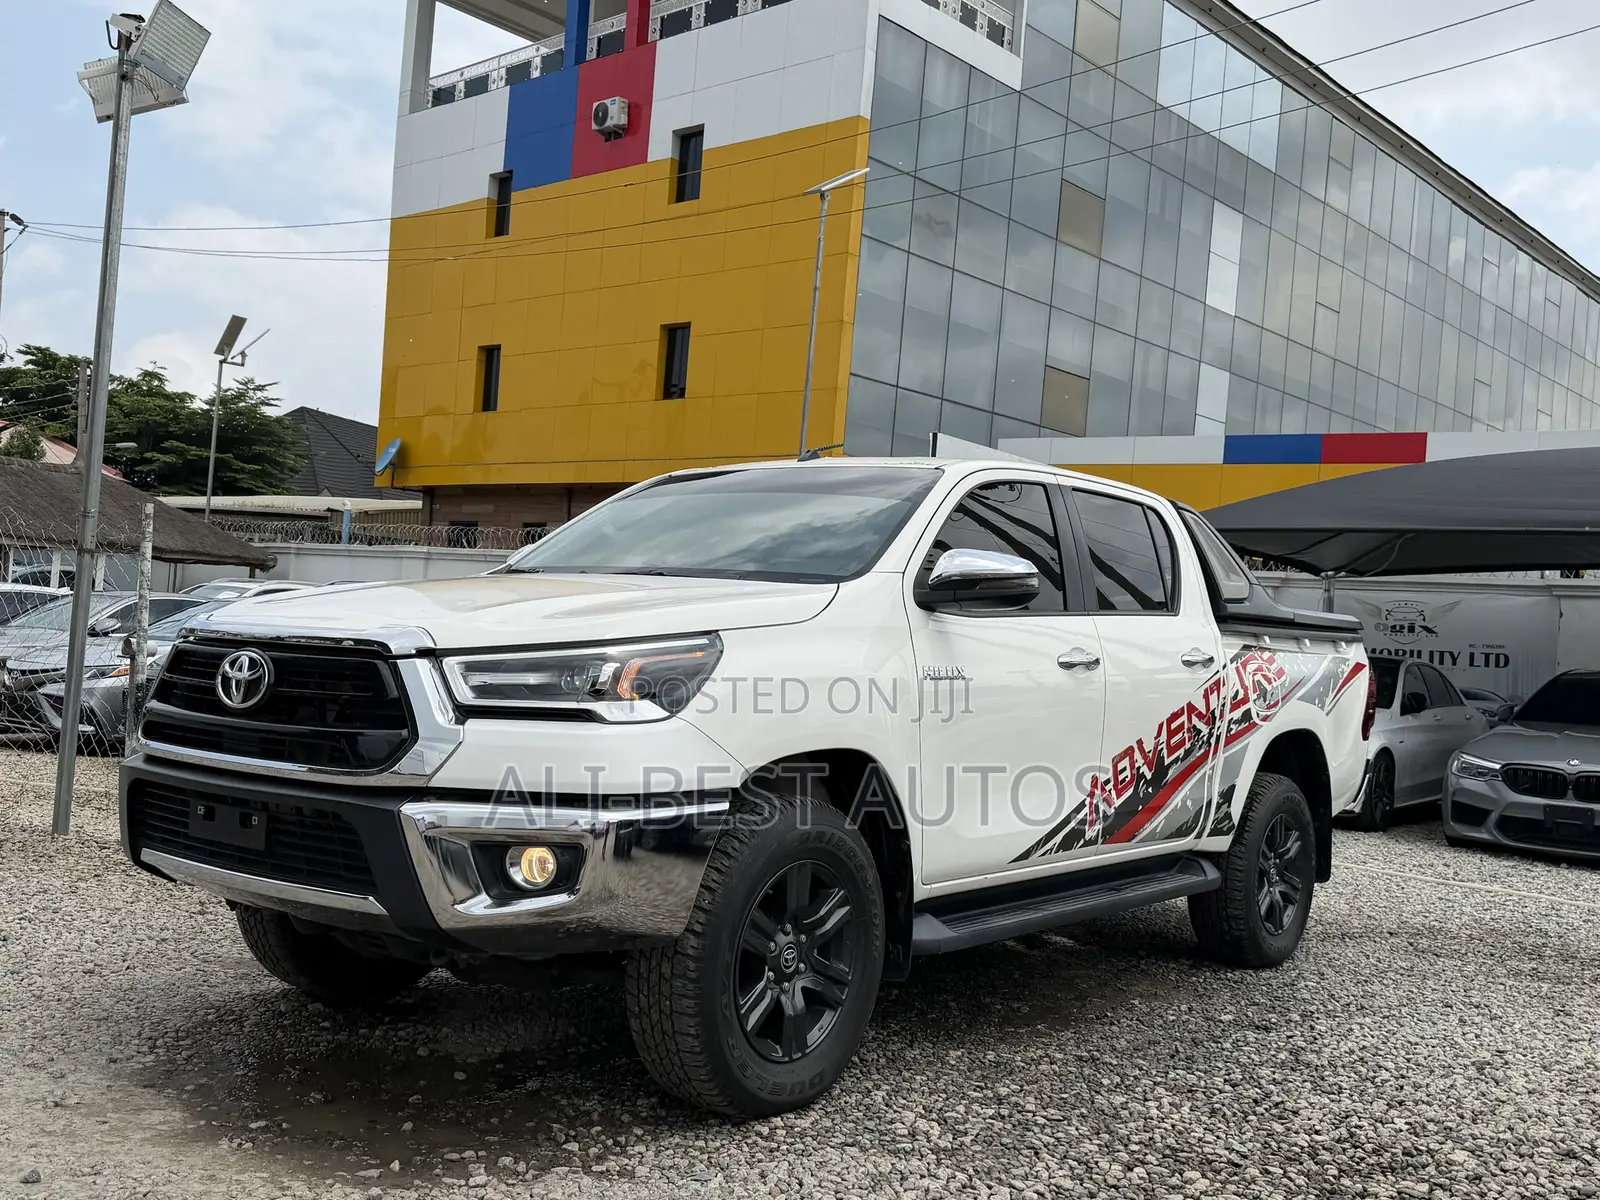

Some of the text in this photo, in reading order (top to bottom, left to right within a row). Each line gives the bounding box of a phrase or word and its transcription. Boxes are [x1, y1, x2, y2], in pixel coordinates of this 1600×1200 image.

[1469, 651, 1510, 669] LTD
[1087, 646, 1287, 831] ADVENTURE
[727, 1034, 825, 1097] DUELER
